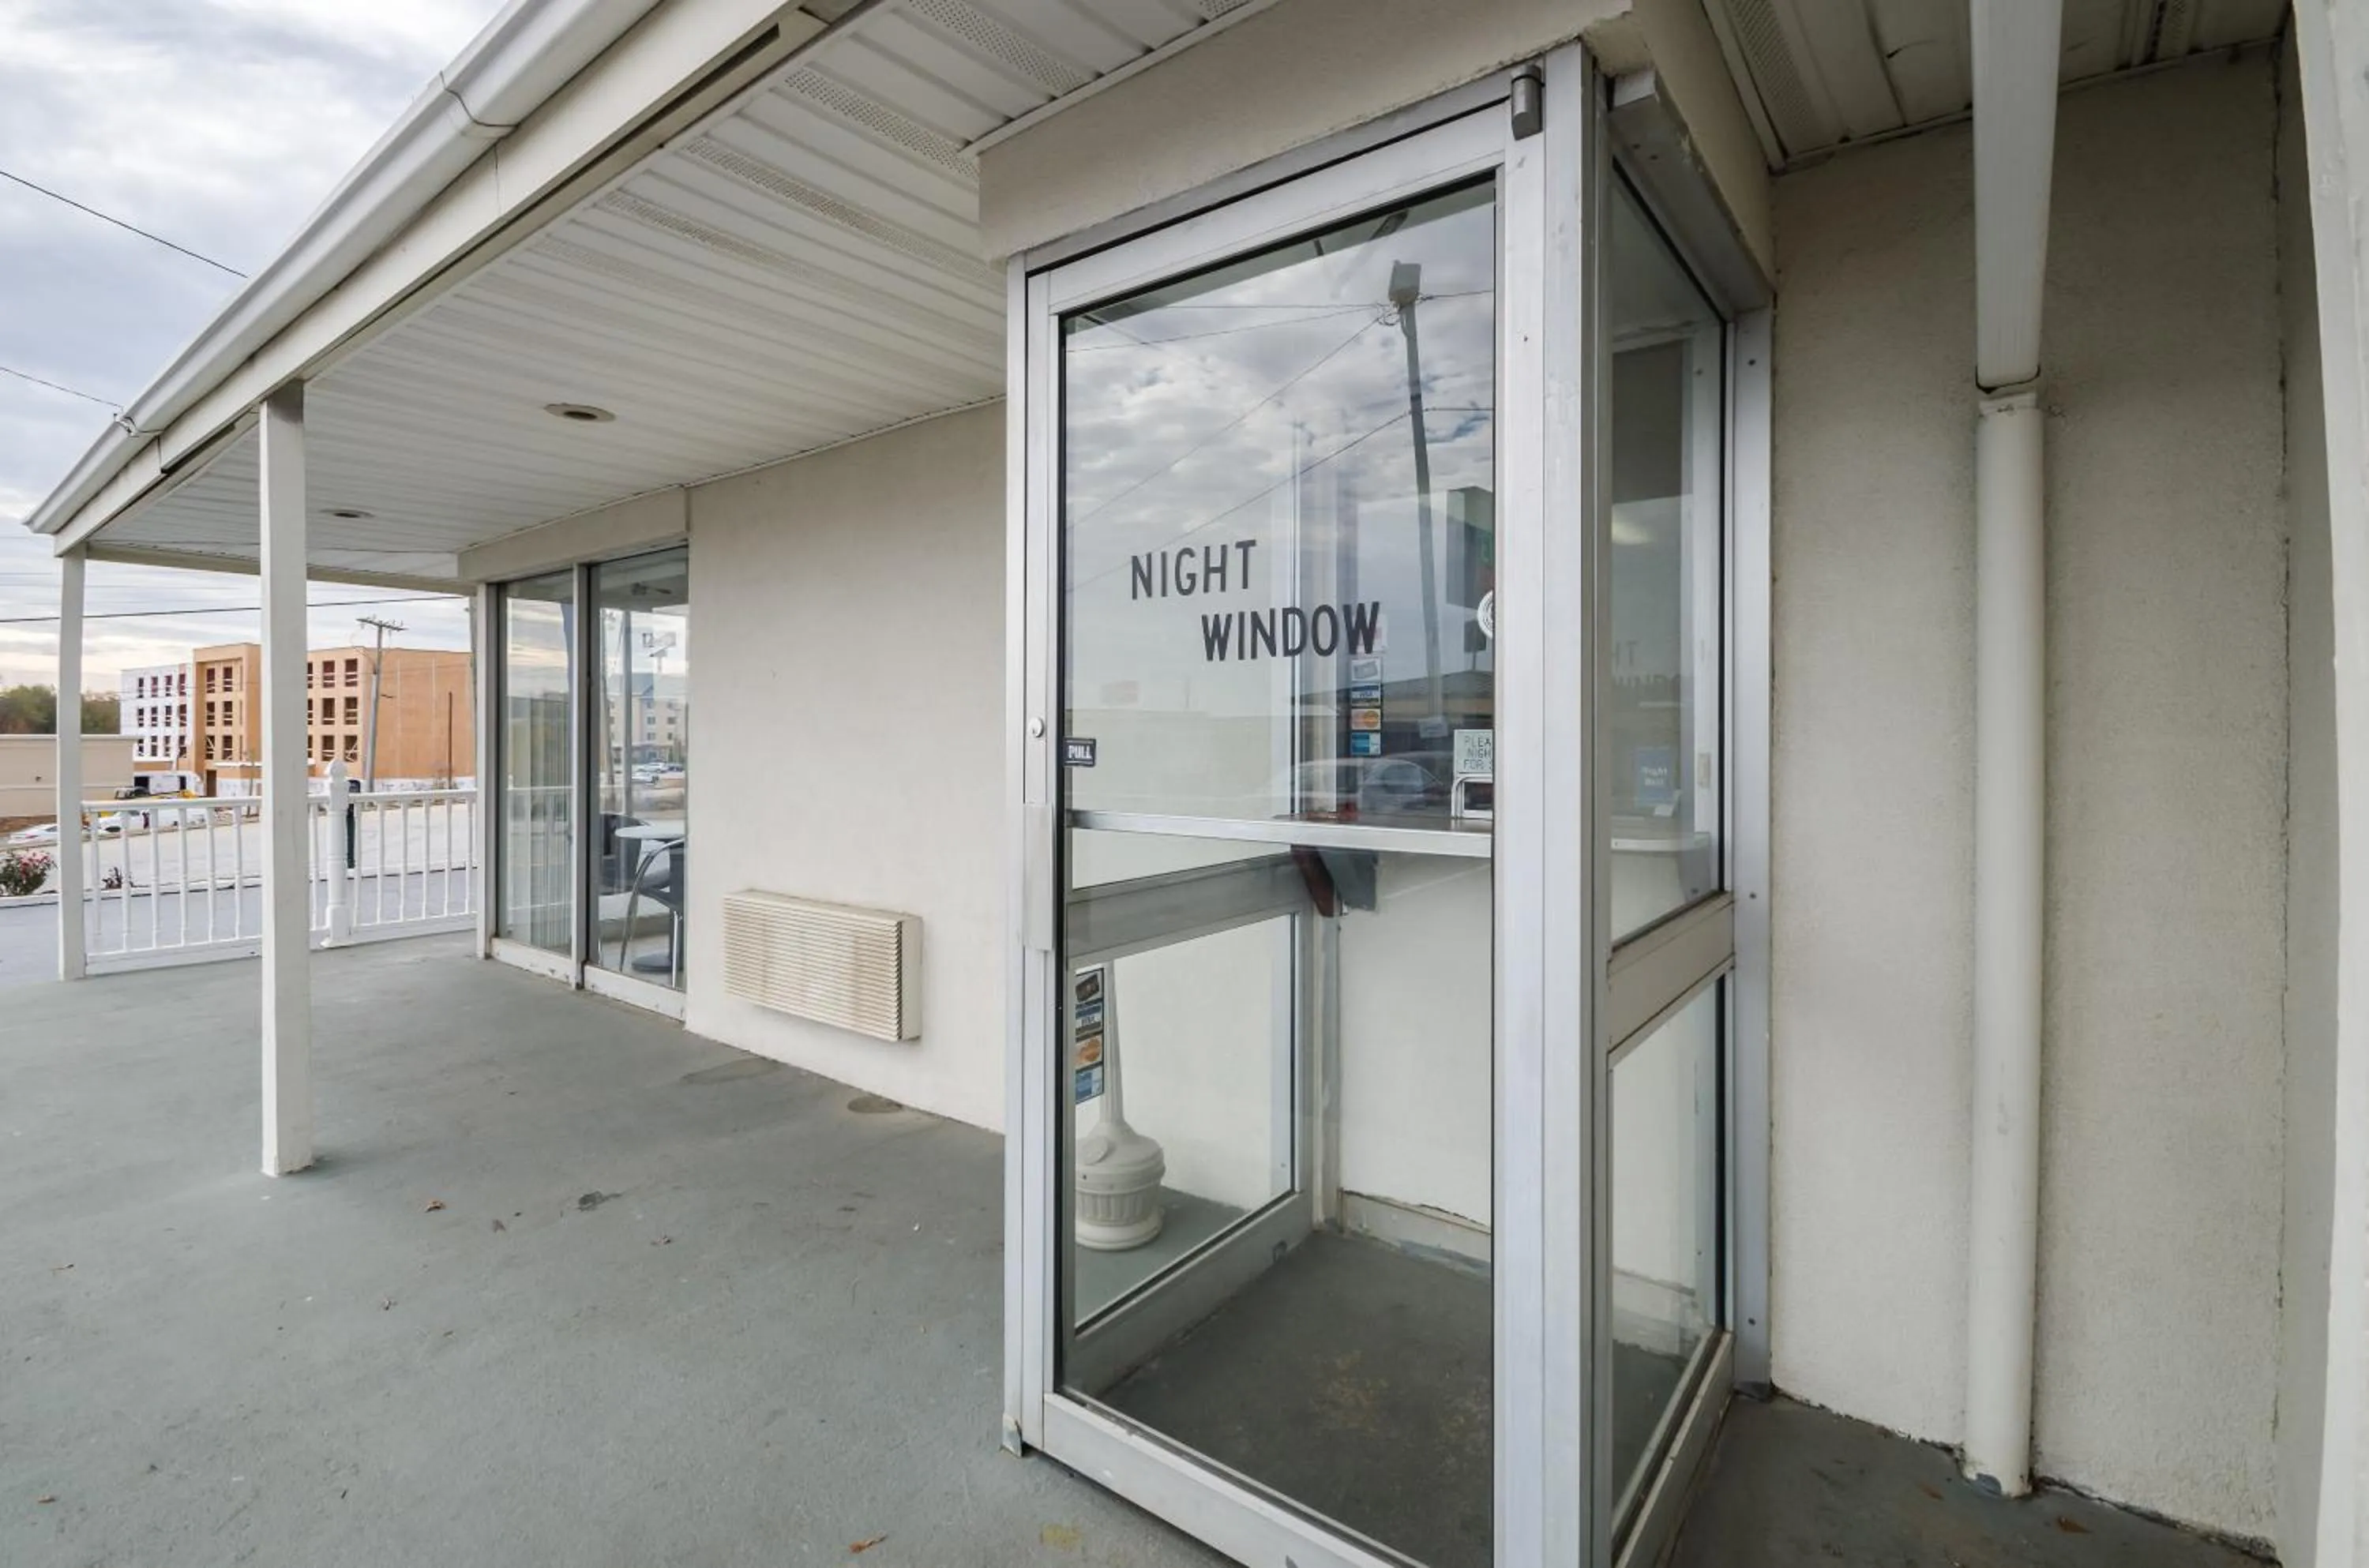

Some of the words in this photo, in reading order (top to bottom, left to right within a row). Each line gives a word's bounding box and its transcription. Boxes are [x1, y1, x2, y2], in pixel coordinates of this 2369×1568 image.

[1132, 539, 1256, 600] NIGHT
[1201, 601, 1380, 662] WINDOW
[1463, 735, 1492, 748] PLEA
[1068, 745, 1093, 759] PULL
[1467, 748, 1492, 759] NIGH
